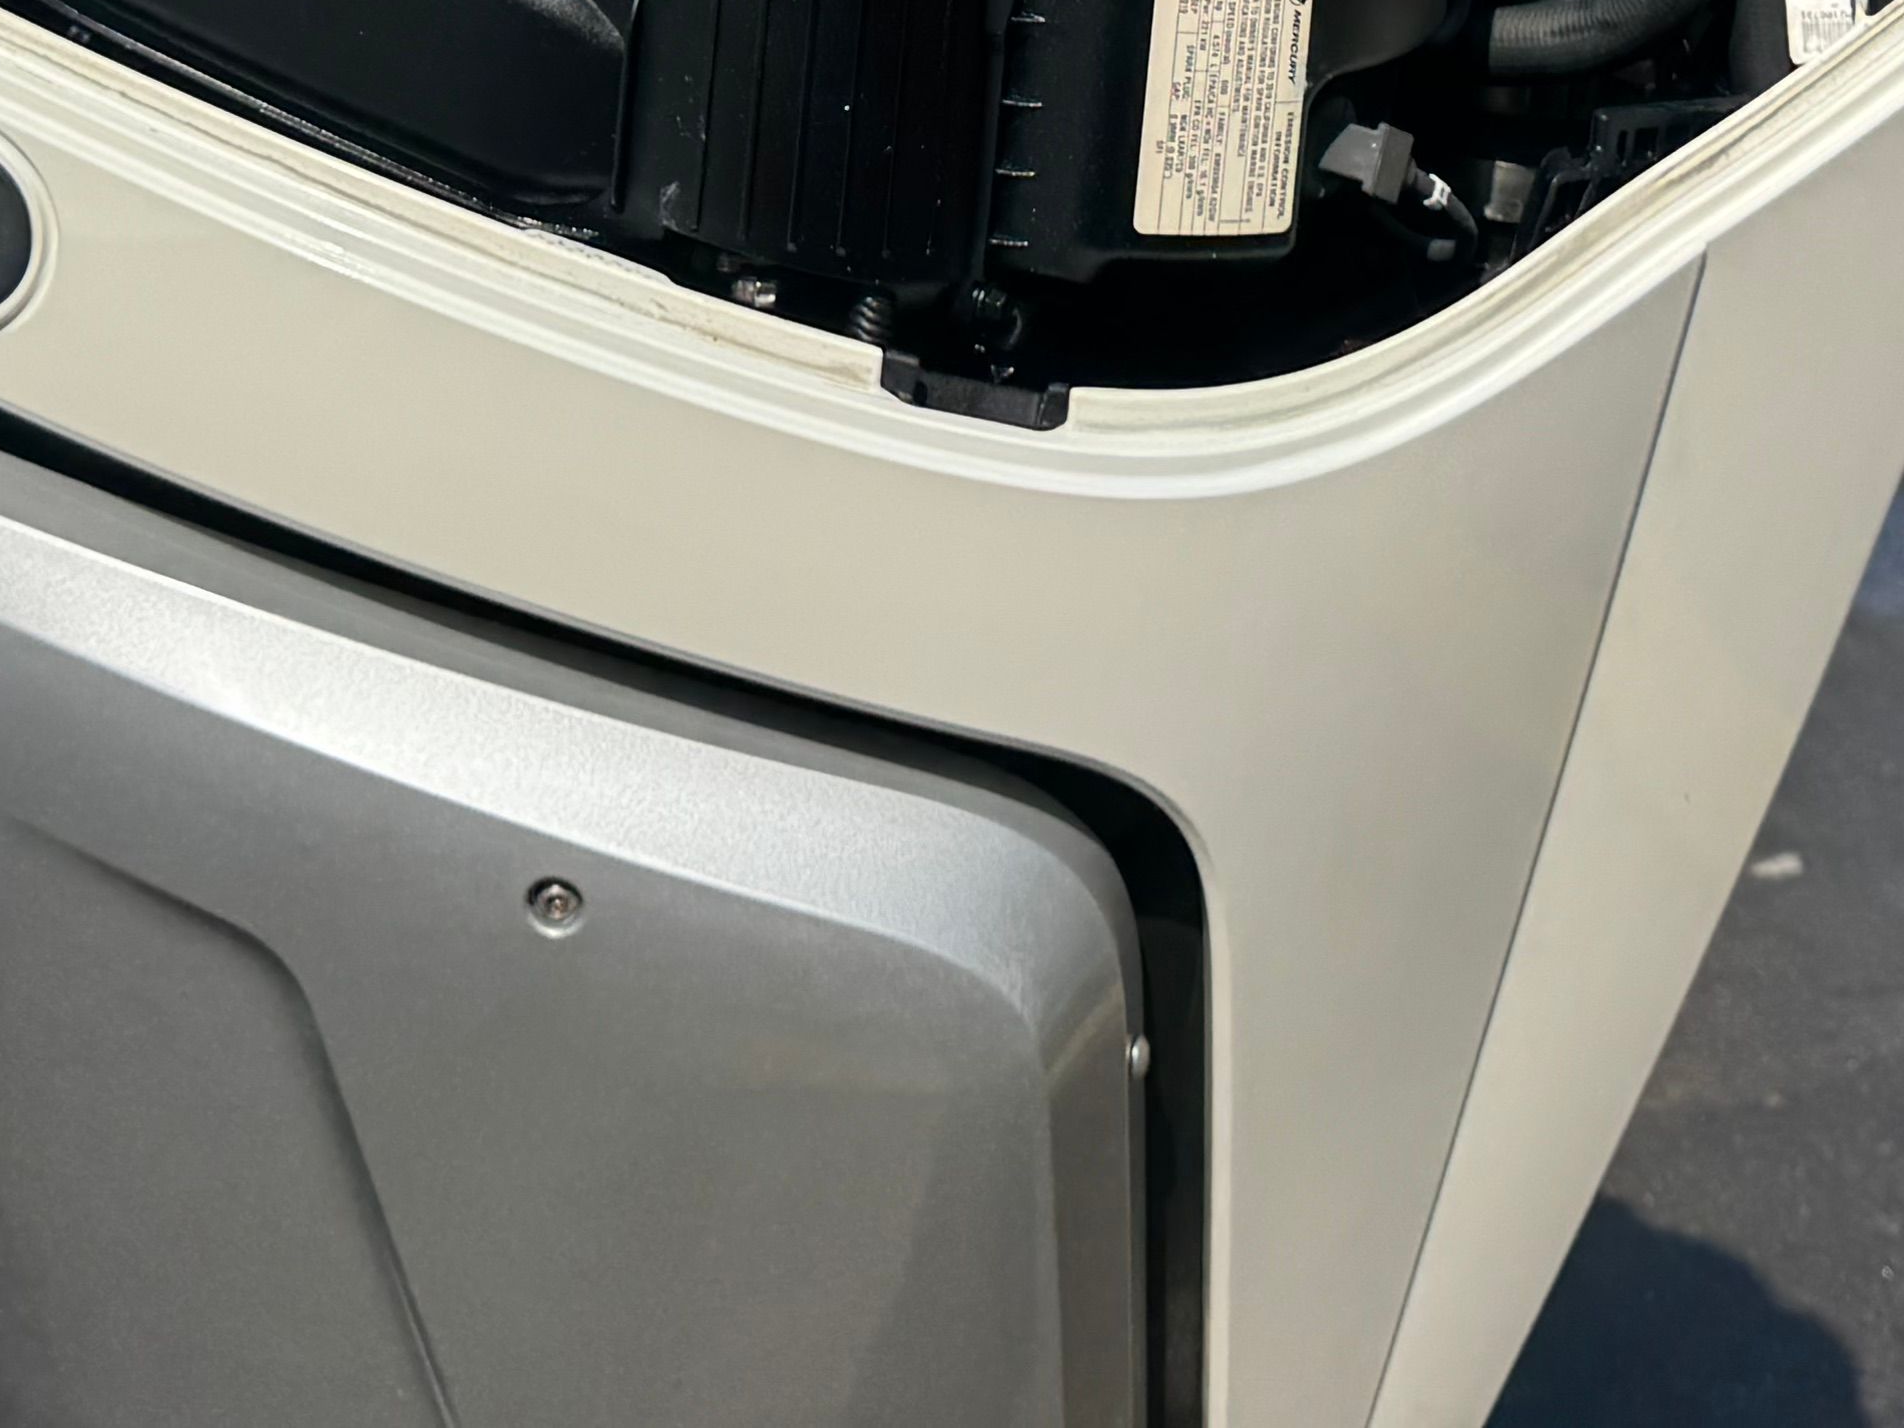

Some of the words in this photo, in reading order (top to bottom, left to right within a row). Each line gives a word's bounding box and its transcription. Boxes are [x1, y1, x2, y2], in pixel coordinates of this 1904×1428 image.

[1225, 1, 1236, 29] SPEED
[1286, 8, 1302, 85] MERCURY
[1256, 69, 1265, 84] FOR
[1266, 71, 1275, 80] TO
[1281, 111, 1294, 163] EMISSION
[1268, 130, 1282, 206] INFORMATION
[1276, 167, 1289, 219] CONTROL
